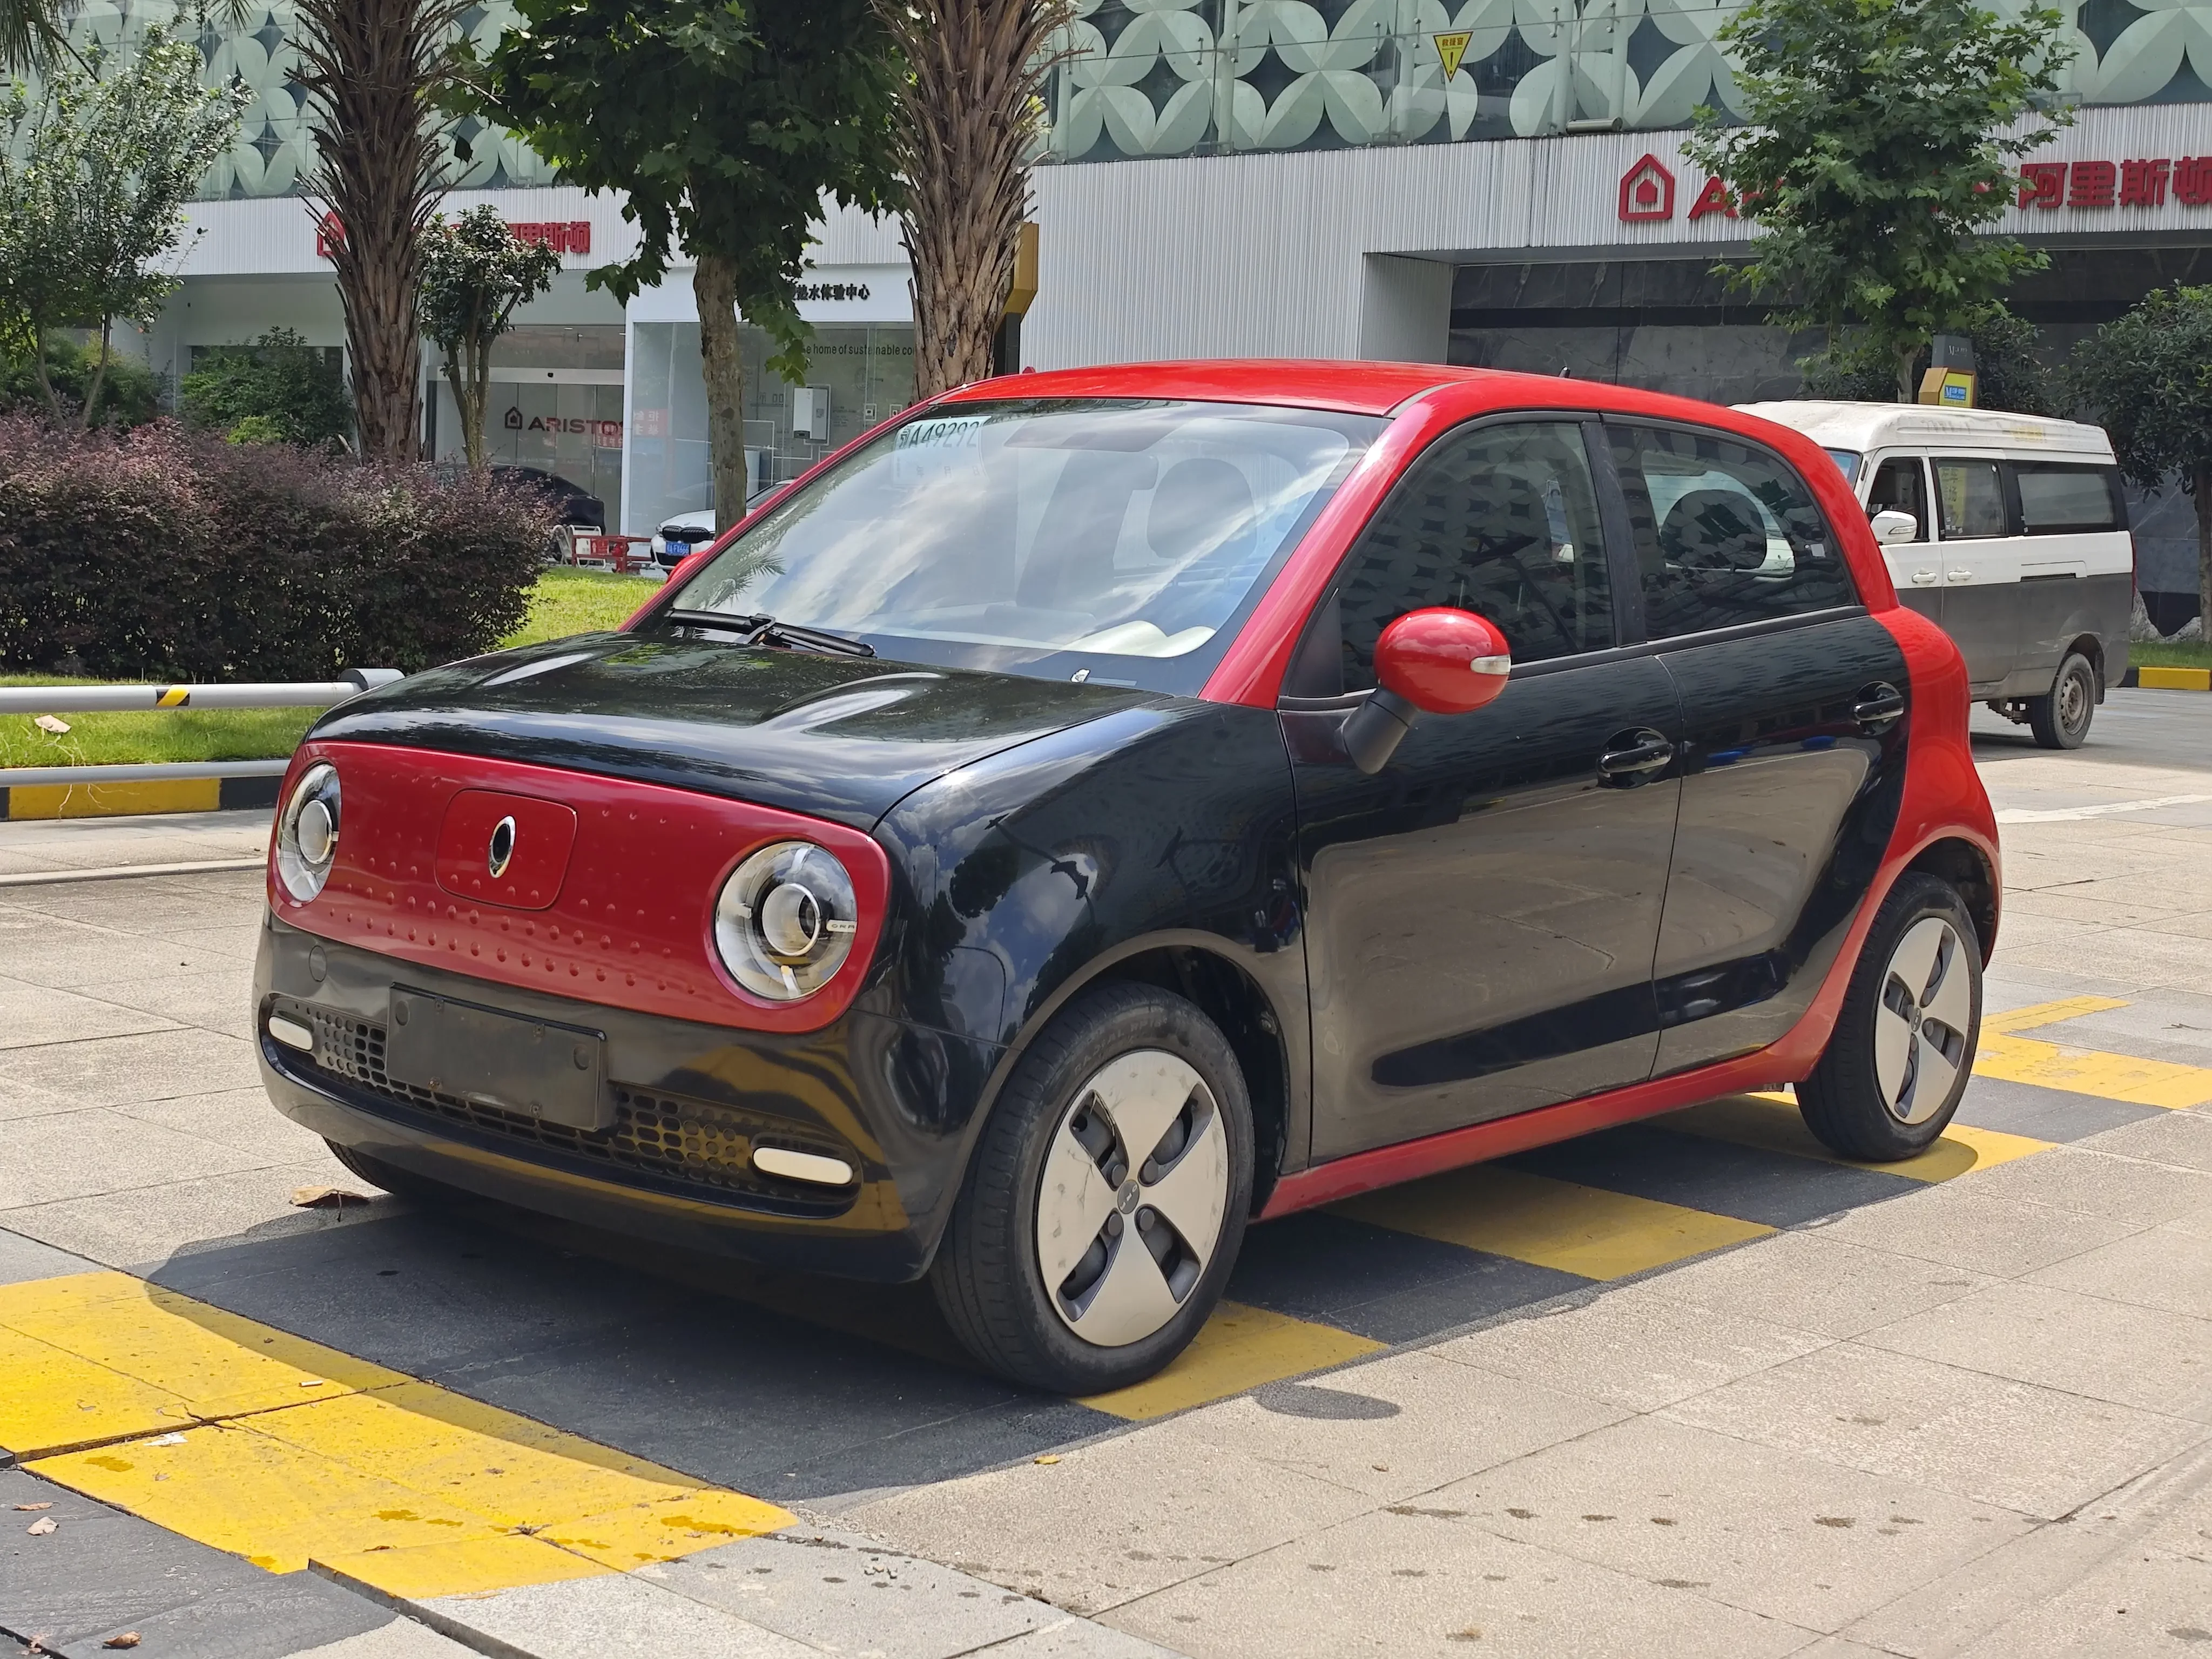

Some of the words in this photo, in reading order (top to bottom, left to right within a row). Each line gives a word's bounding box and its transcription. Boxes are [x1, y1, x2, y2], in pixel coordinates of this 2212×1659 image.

[2019, 156, 2212, 209] 阿里斯顿
[507, 221, 591, 253] 里斯顿
[792, 284, 870, 300] 热水体验中心
[813, 344, 837, 354] home
[839, 344, 847, 354] of
